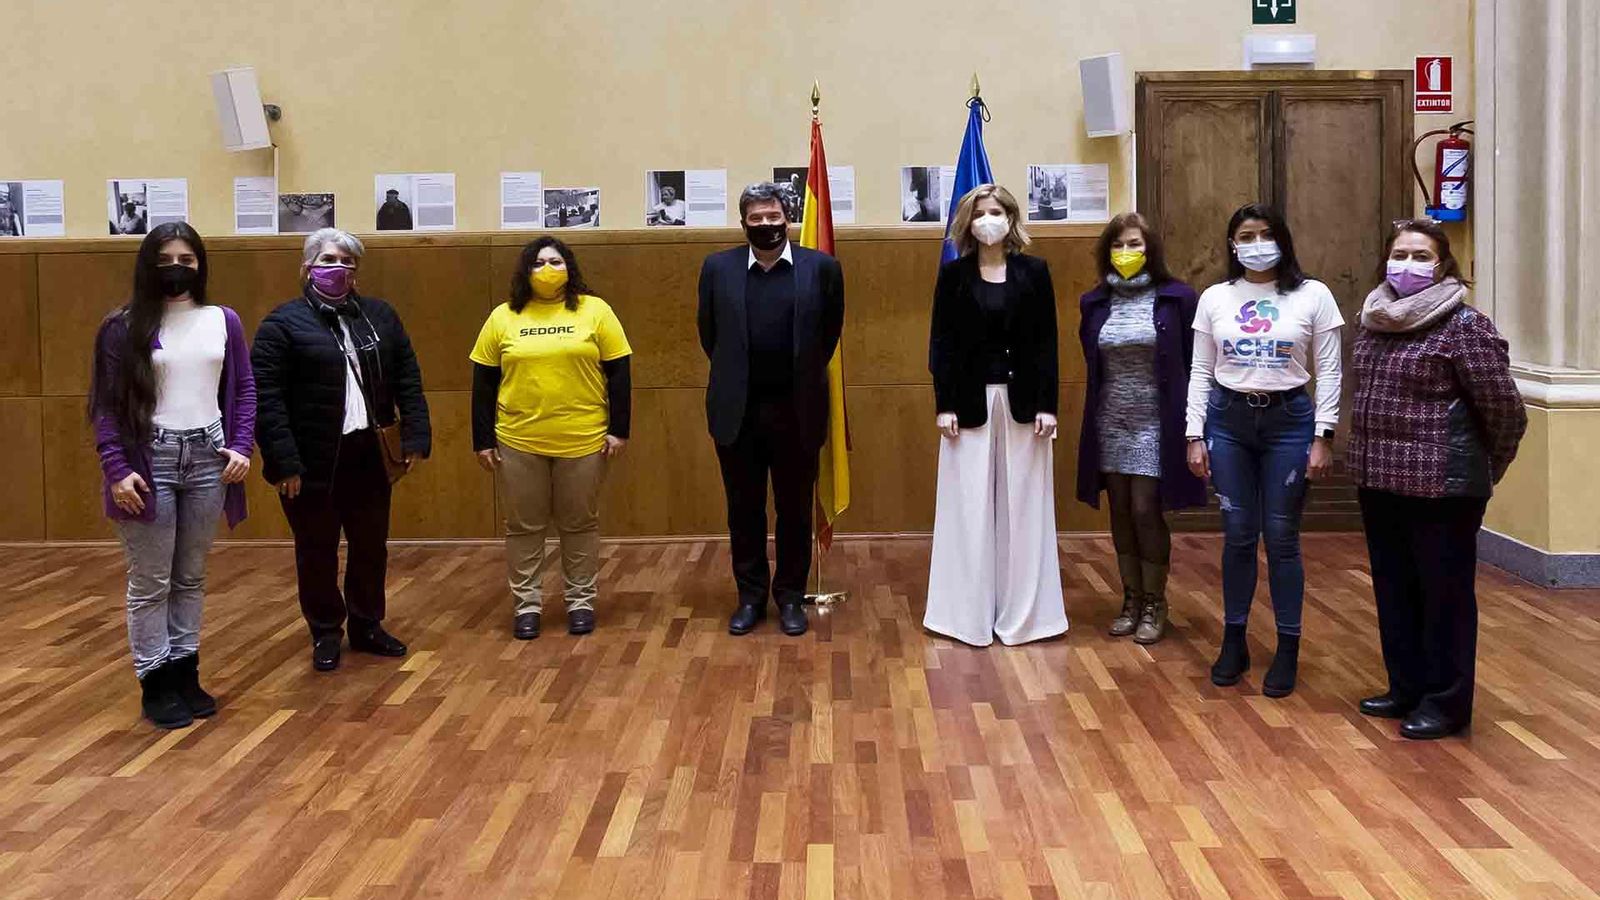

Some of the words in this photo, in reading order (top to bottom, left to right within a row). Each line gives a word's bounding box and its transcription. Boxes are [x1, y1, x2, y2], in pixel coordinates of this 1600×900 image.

[1417, 99, 1450, 107] EXTINTOR
[519, 326, 575, 337] SEDOAC
[1222, 339, 1295, 359] ACHE
